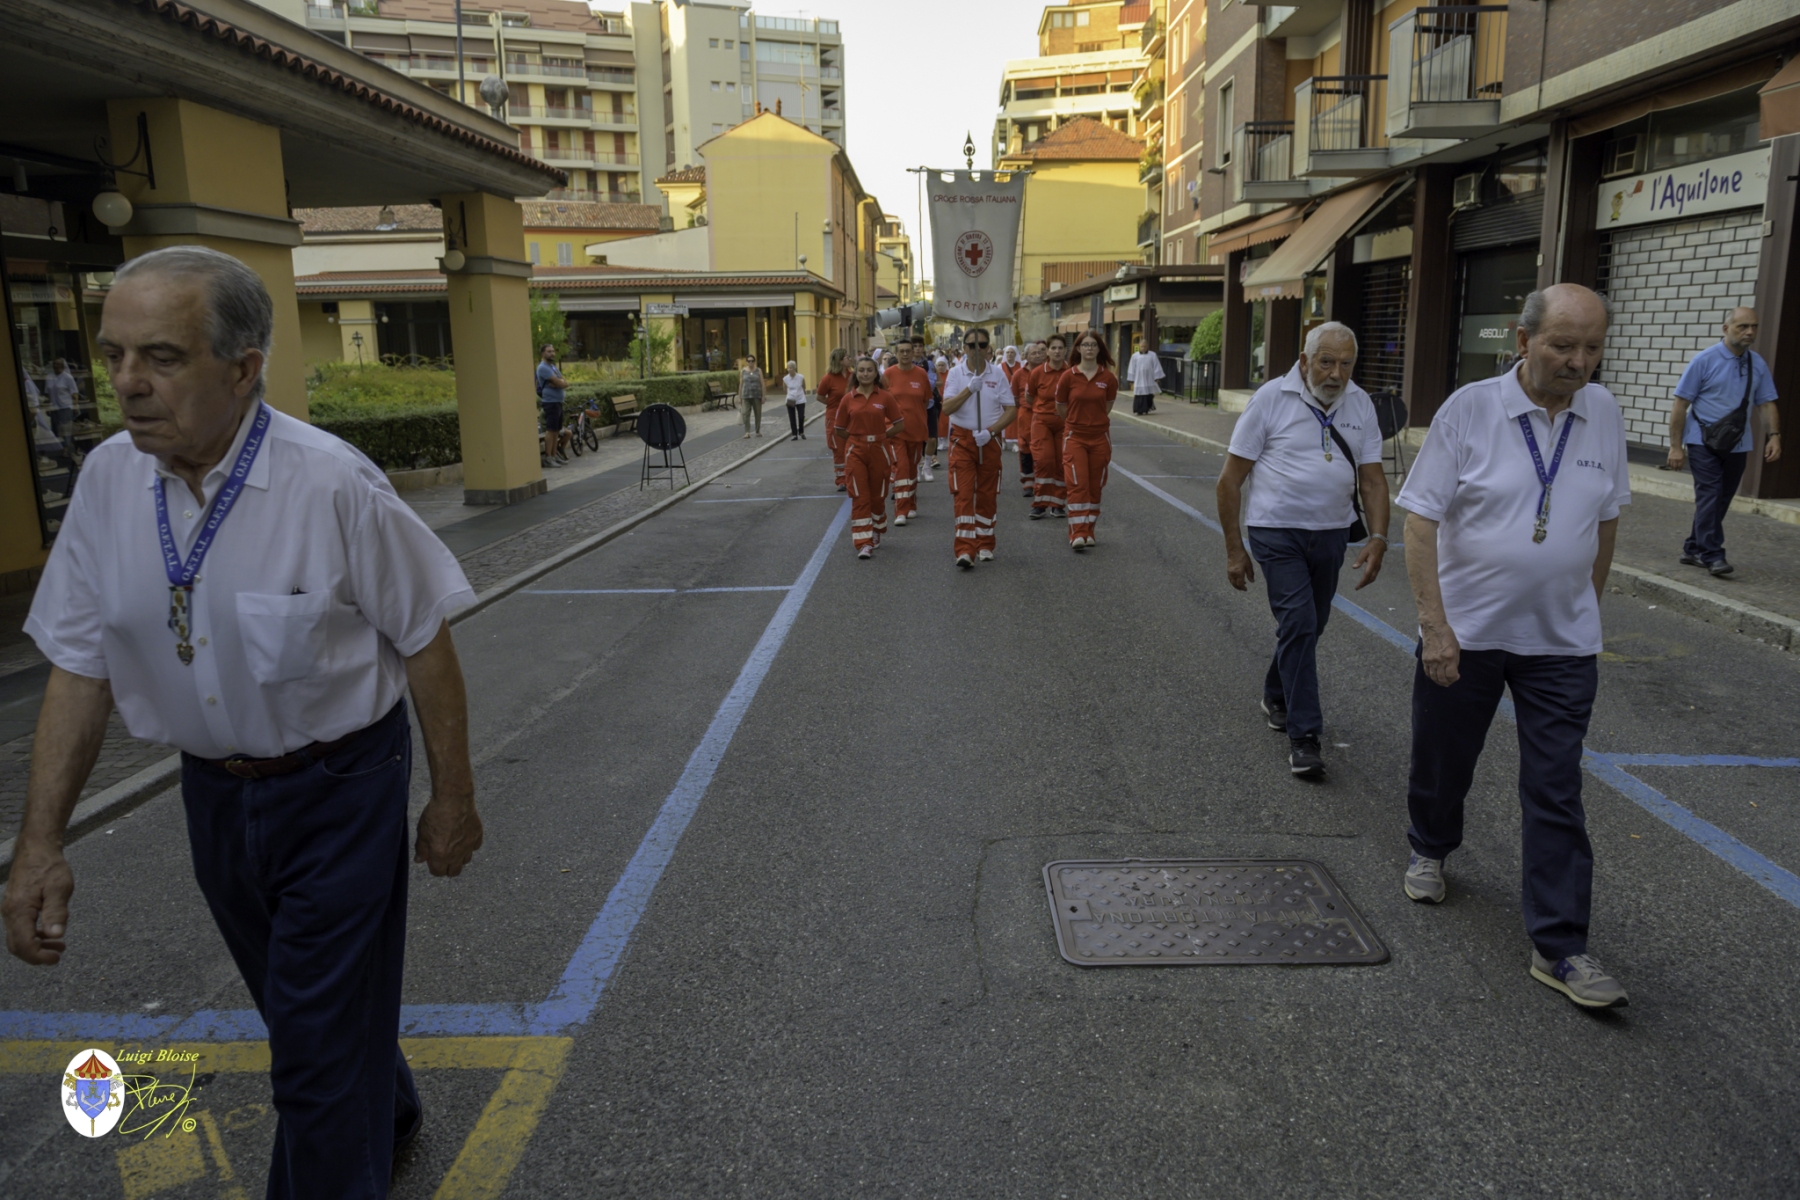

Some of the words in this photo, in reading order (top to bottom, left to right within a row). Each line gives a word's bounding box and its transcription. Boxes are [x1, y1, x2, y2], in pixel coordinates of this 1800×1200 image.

[934, 194, 958, 204] CROCE
[960, 195, 984, 203] ROSSA
[986, 195, 1017, 204] ITALIANA
[1650, 168, 1742, 215] l'Aquilone
[946, 300, 999, 311] TORTONA
[1479, 328, 1509, 339] ABSOLUT
[234, 436, 262, 478] O.F.T.A.L.
[208, 485, 239, 530] O.F.T.A.L.
[160, 523, 178, 572] O.F.T.A.L.
[182, 536, 210, 582] O.F.T.A.L.
[1126, 895, 1269, 906] FOGNATURA
[1092, 911, 1215, 924] TORTONA
